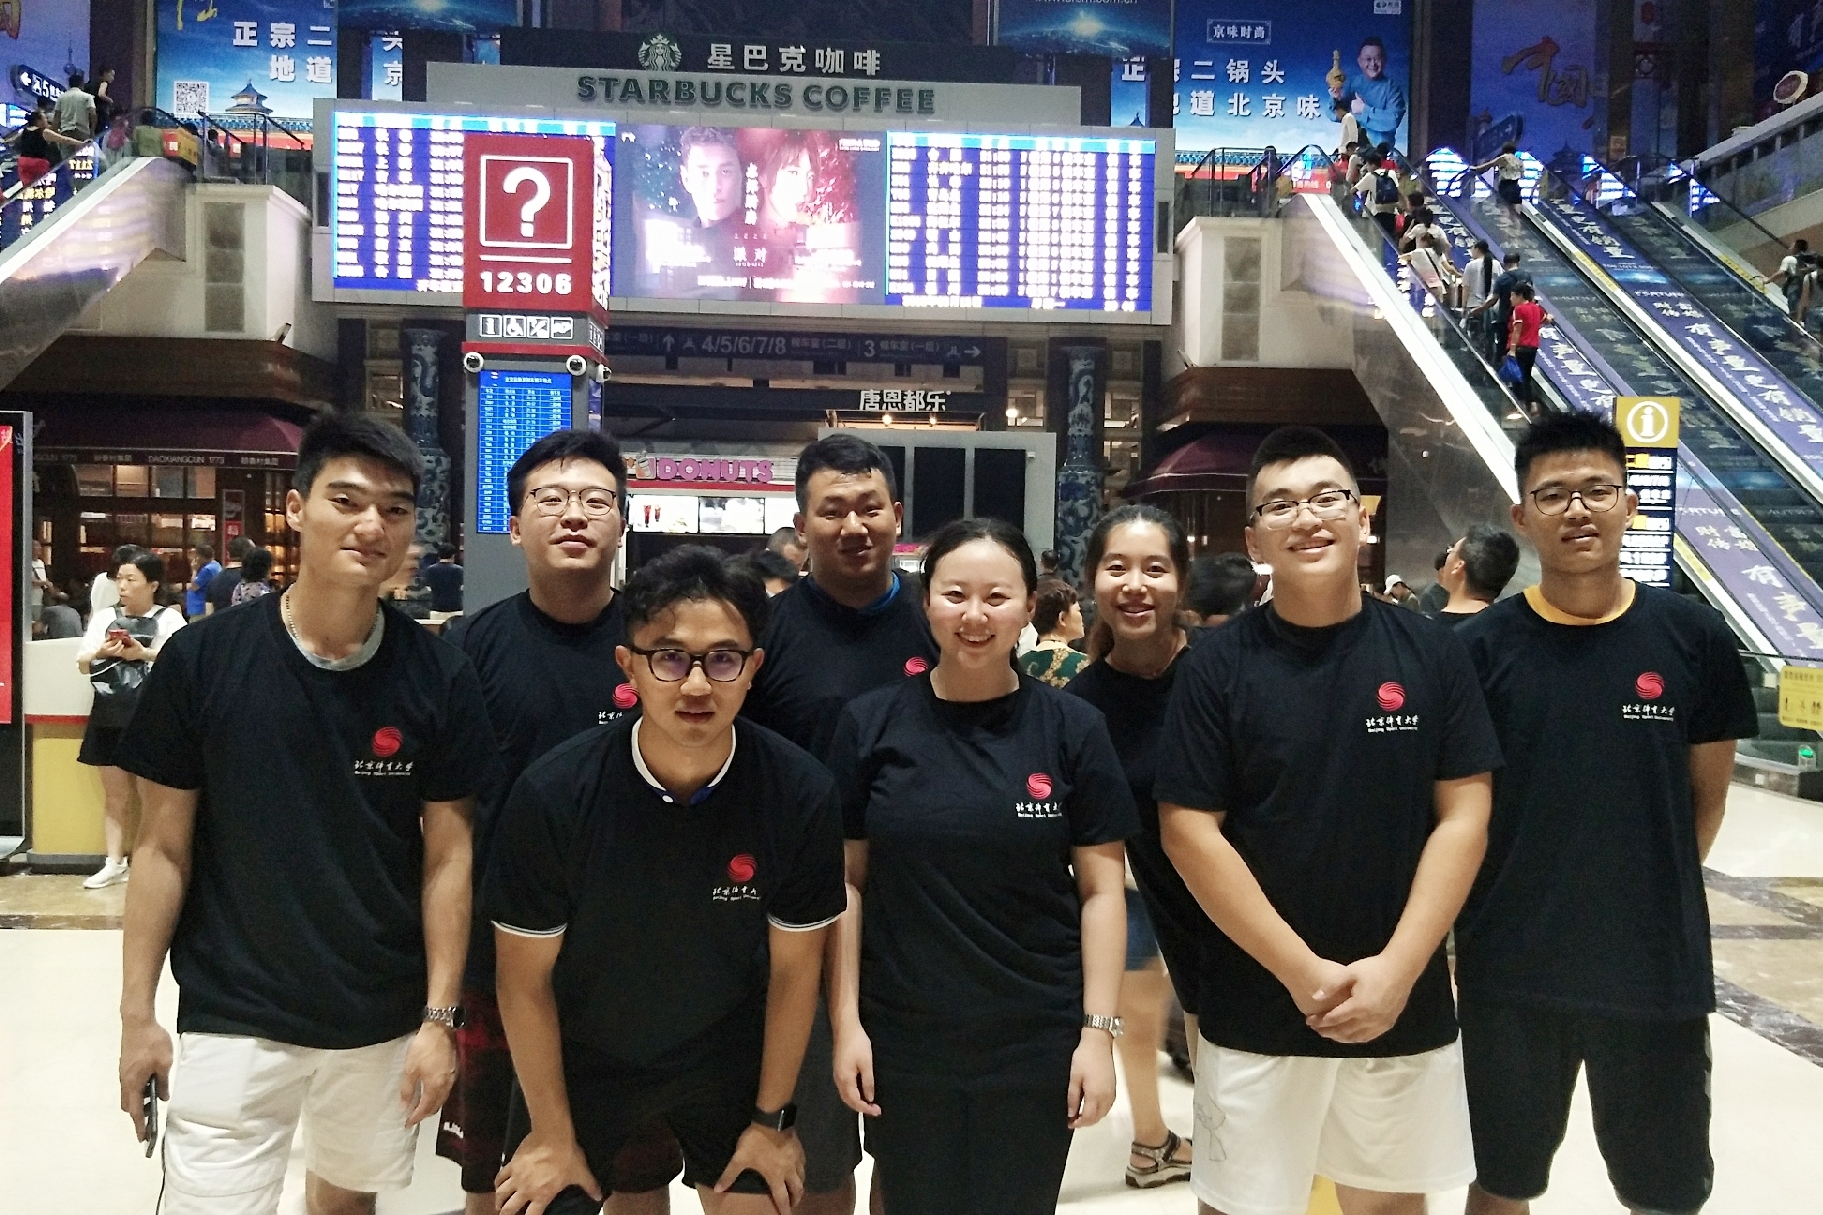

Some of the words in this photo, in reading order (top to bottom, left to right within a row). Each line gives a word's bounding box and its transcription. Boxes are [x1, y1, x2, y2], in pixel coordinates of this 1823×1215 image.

[232, 21, 332, 48] 正宗二
[1213, 23, 1266, 39] 京味时尚
[269, 54, 332, 83] 地道
[706, 43, 881, 75] 星巴克咖啡
[1174, 58, 1285, 84] 二锅头
[576, 75, 793, 109] STARBUCKS
[802, 84, 936, 113] COFFEE
[1173, 90, 1321, 119] 道北京味
[479, 271, 572, 295] 12306
[702, 335, 787, 355] 4/5/6/7/8
[863, 340, 876, 358] 3
[859, 389, 946, 412] 唐恩都乐
[656, 457, 773, 484] DONUTS
